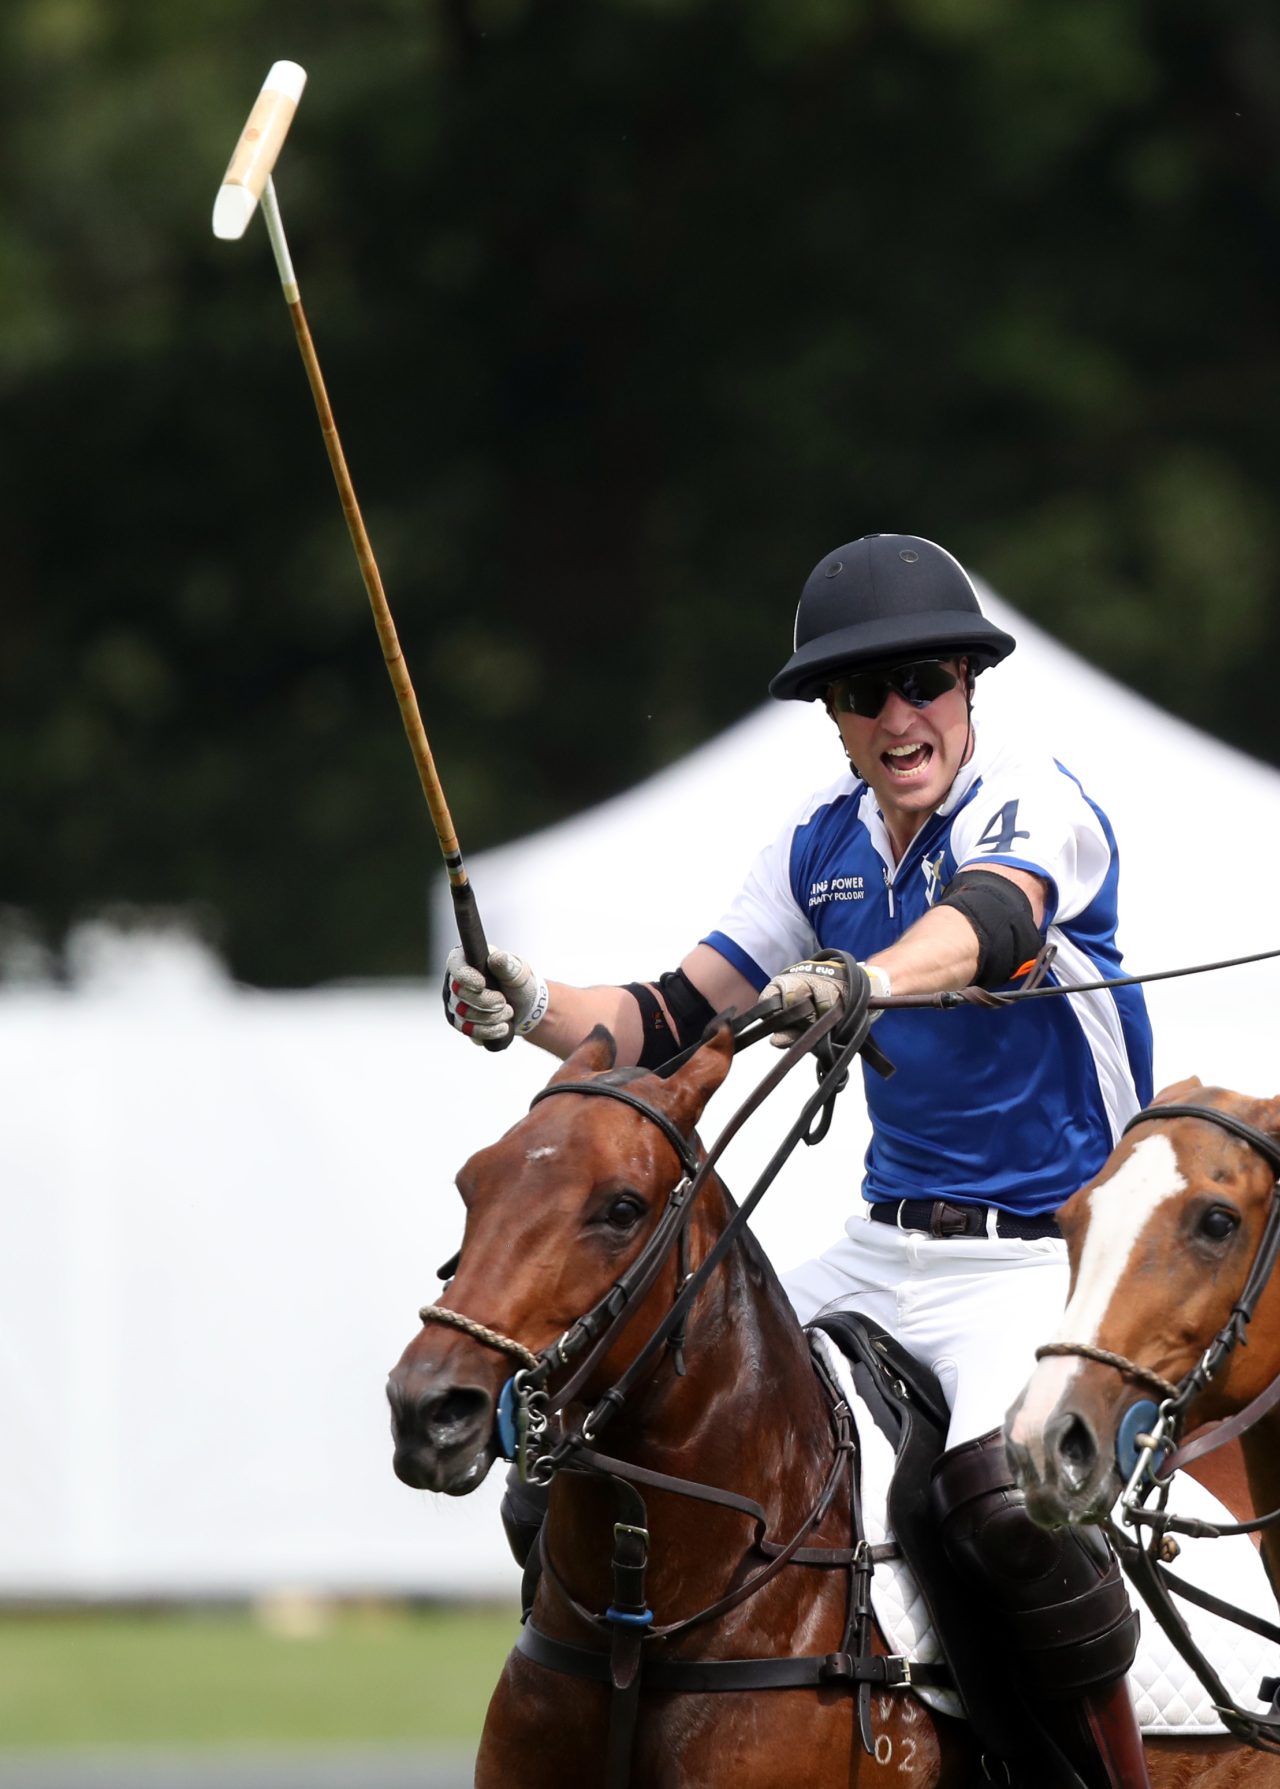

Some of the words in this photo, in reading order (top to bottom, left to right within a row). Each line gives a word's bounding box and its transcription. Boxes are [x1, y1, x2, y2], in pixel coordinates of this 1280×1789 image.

[975, 798, 1031, 853] 4
[810, 880, 828, 895] ING
[831, 876, 864, 890] POWER
[834, 891, 852, 901] POLO
[853, 891, 865, 900] DAY
[815, 965, 835, 976] ona
[531, 985, 547, 1020] ona
[874, 1733, 917, 1773] 02
